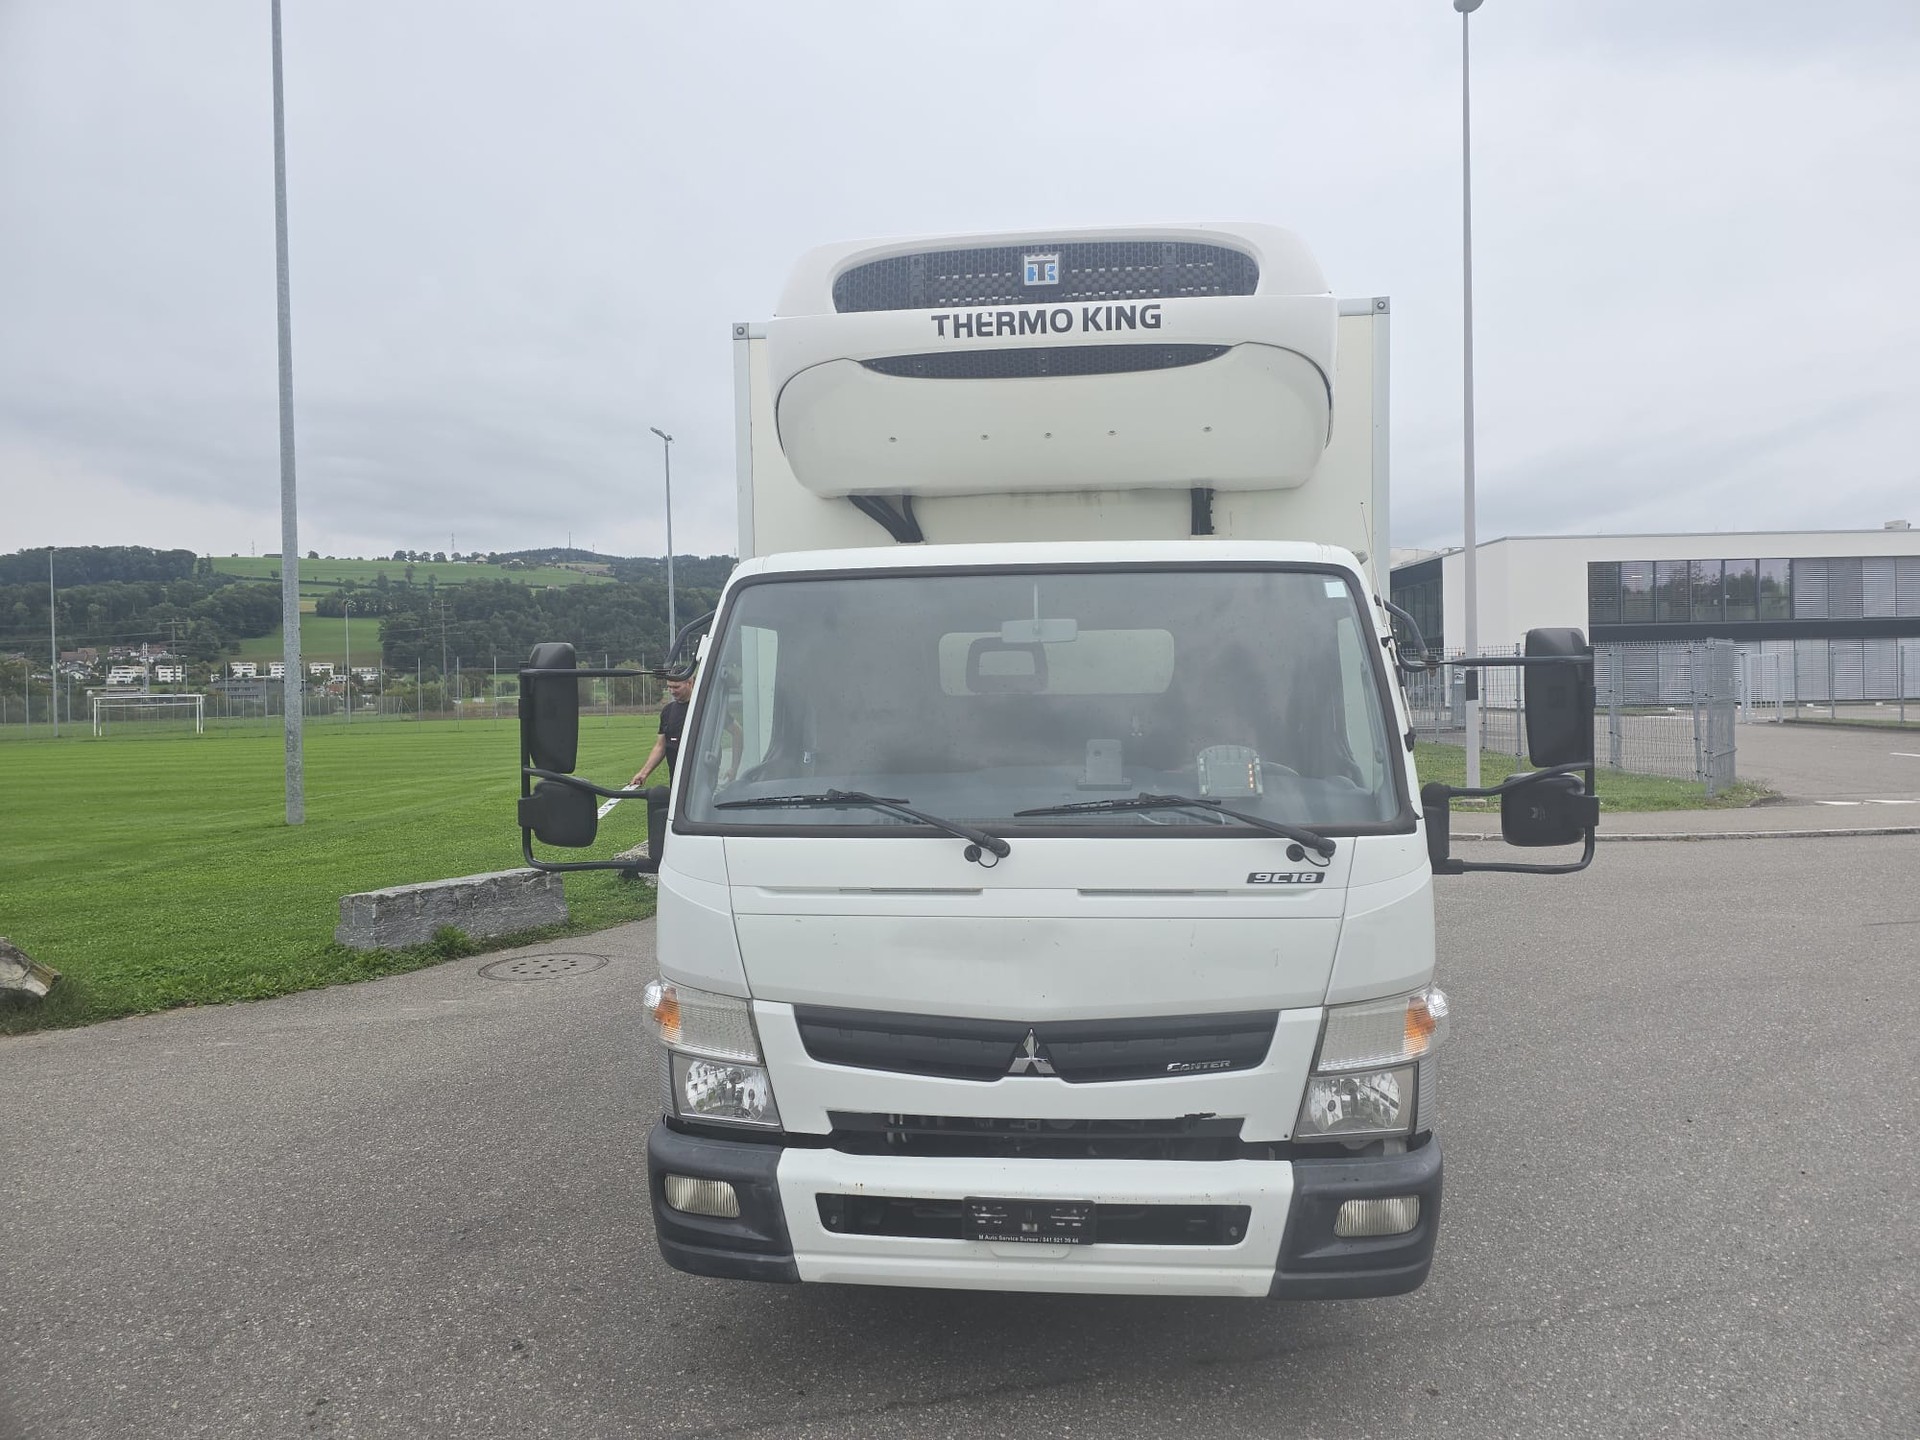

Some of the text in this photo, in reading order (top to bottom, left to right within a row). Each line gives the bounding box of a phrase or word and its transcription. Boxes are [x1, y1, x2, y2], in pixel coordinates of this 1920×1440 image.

[931, 304, 1162, 339] THERMO KING
[1253, 873, 1318, 883] 9C18
[998, 1234, 1019, 1242] Service
